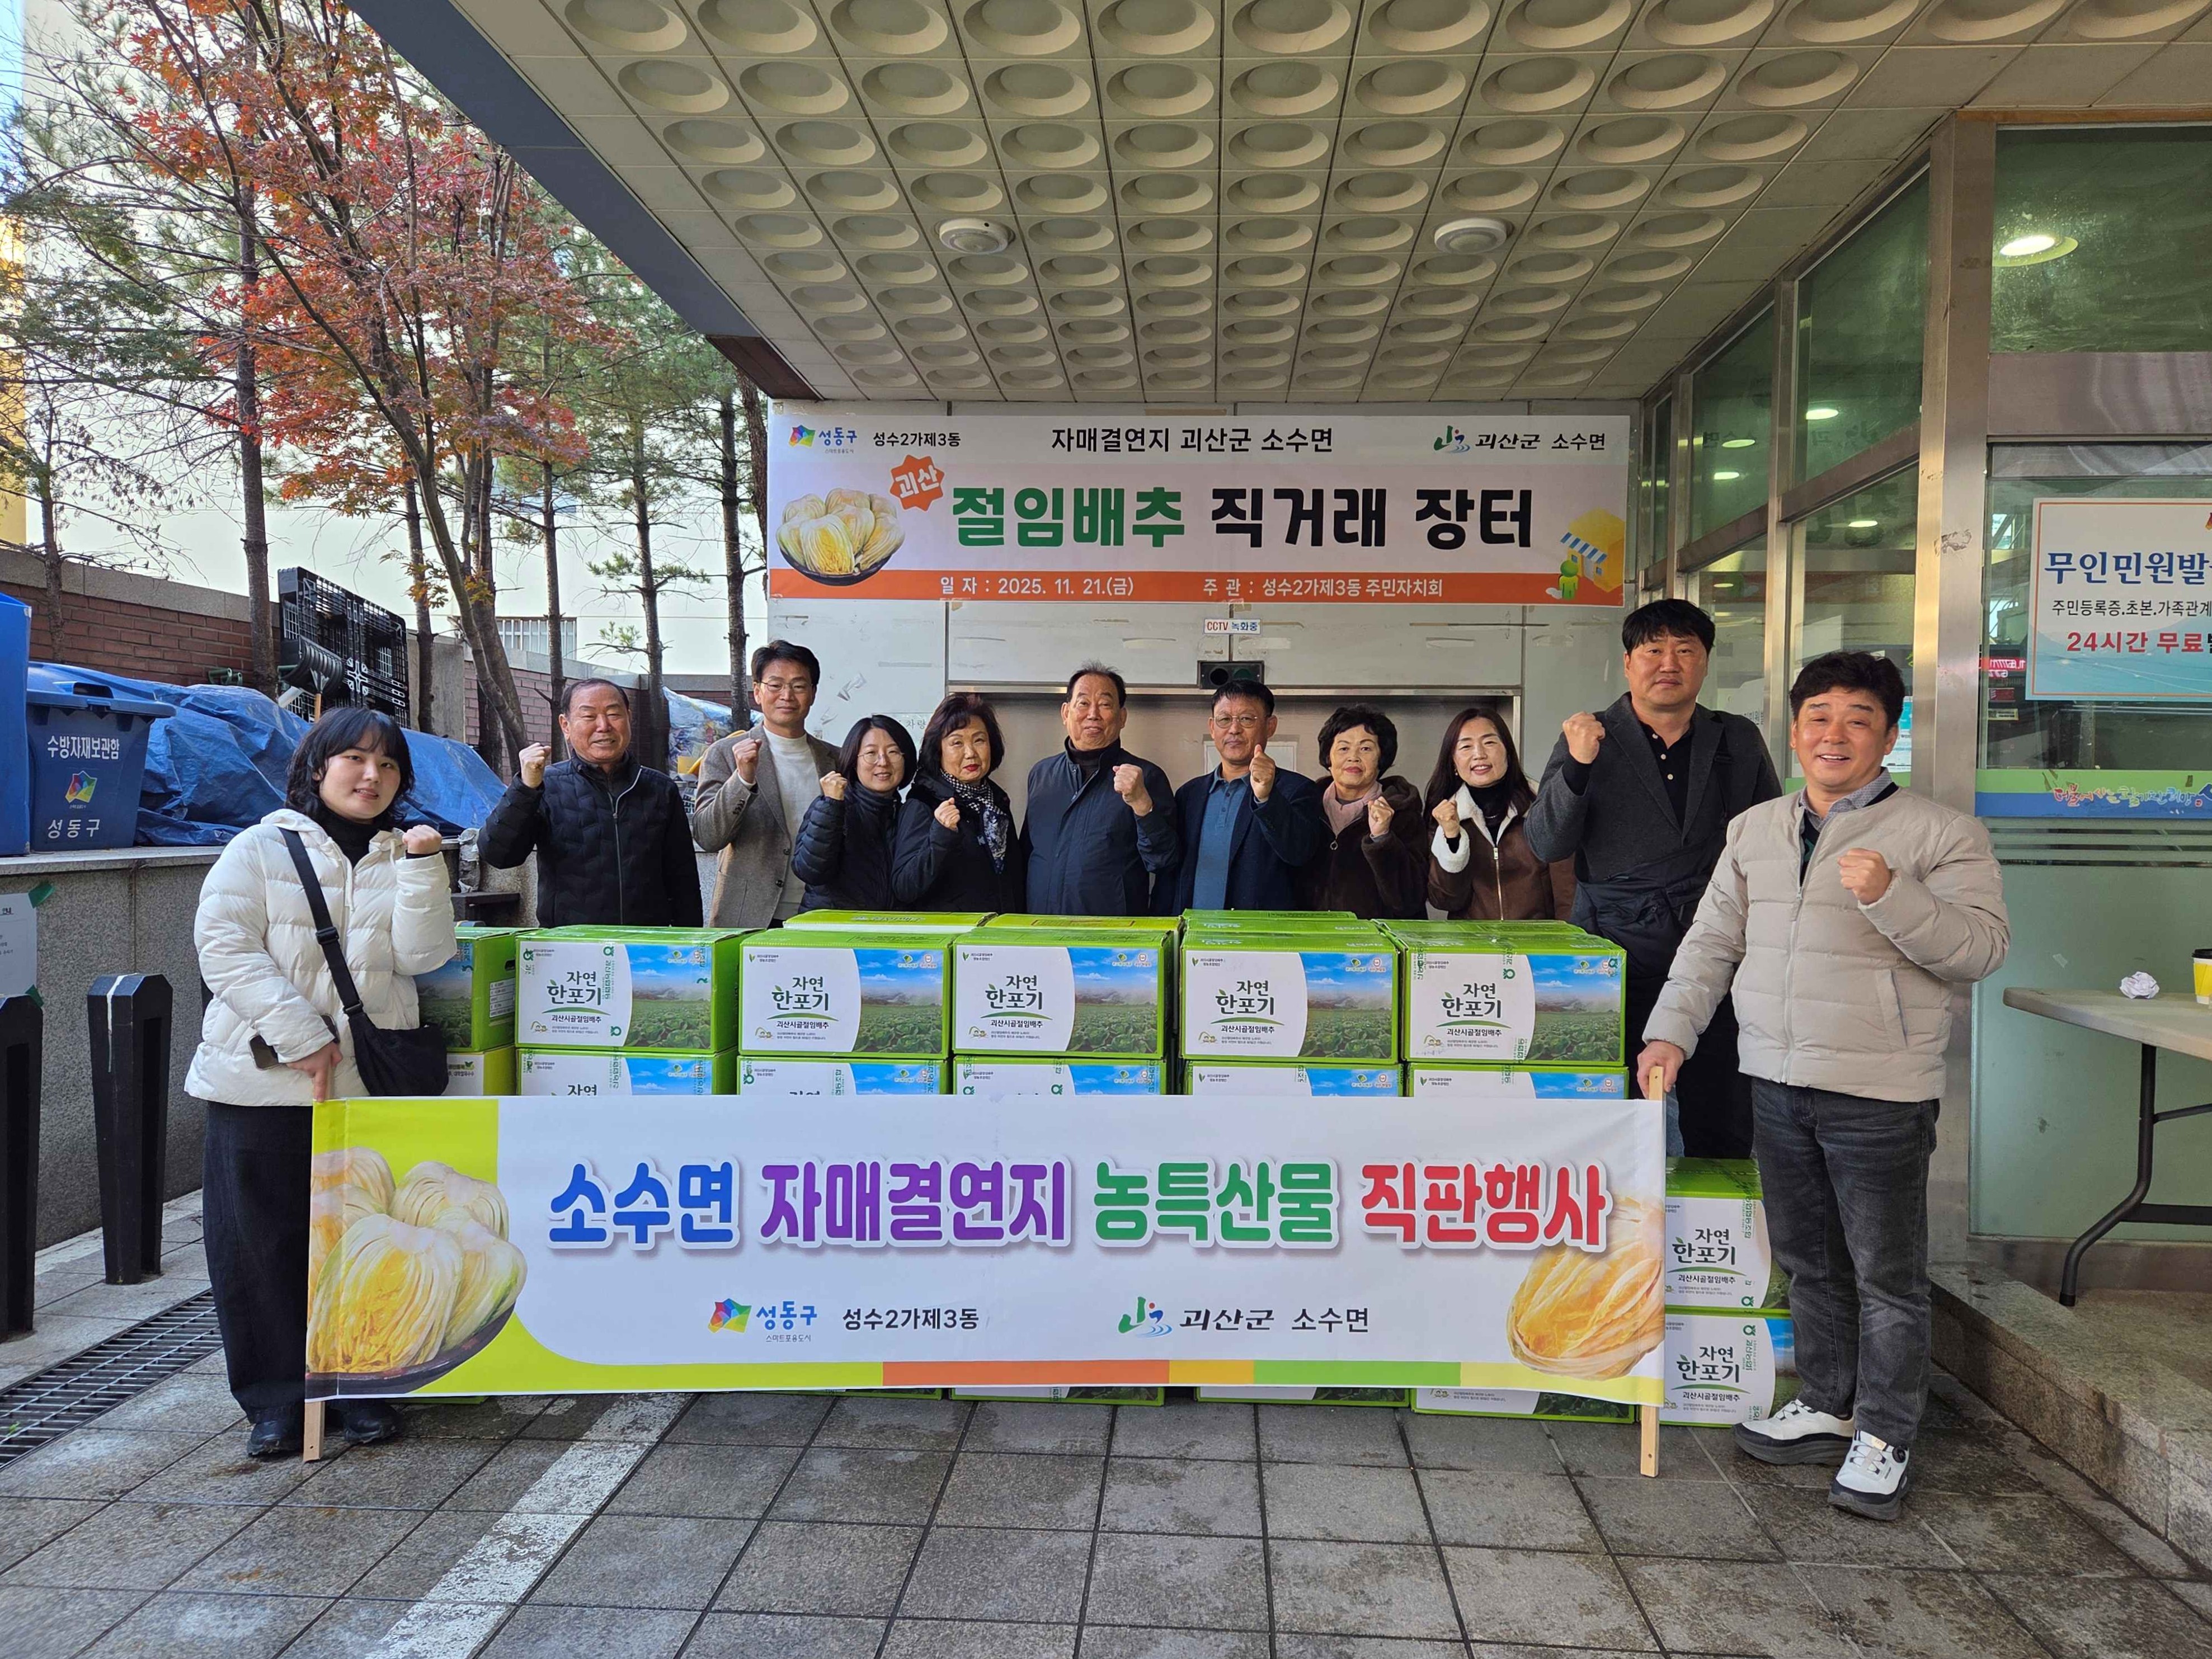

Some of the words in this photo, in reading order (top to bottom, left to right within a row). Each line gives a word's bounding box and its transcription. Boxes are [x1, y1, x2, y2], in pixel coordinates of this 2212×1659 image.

[818, 427, 857, 446] 성동구
[873, 432, 961, 447] 성수2가제3동
[1052, 428, 1169, 452] 자매결연지
[1180, 427, 1251, 452] 괴산군
[1261, 428, 1333, 452] 소수면
[1475, 433, 1541, 450] 괴산군
[1551, 433, 1606, 451] 소수면
[895, 465, 940, 498] 괴산
[952, 487, 1185, 547] 절임배추
[1212, 488, 1386, 548] 직거래
[1415, 489, 1532, 550] 장터
[2045, 552, 2212, 585] 무인민원발
[998, 578, 1046, 595] 2025.
[1055, 578, 1074, 595] 11.
[1262, 579, 1361, 597] 성수2가제3동
[1366, 579, 1442, 597] 주민자치회
[1207, 621, 1228, 630] CCTV
[1232, 622, 1258, 631] 녹화중
[2067, 632, 2148, 653] 24시간
[48, 736, 119, 760] 수방자재보관함
[566, 972, 596, 987] 자연
[792, 977, 823, 992] 자연
[1006, 975, 1037, 990] 자연
[1236, 981, 1268, 996] 자연
[547, 985, 601, 1006] 한포기
[985, 989, 1042, 1010] 한포기
[1463, 983, 1495, 999] 자연
[771, 991, 829, 1011] 한포기
[1216, 994, 1274, 1015] 한포기
[1441, 997, 1501, 1018] 한포기
[552, 1015, 601, 1023] 괴산시골절임배추
[776, 1021, 829, 1029] 괴산시골절임배추
[991, 1020, 1043, 1028] 괴산시골절임배추
[1221, 1025, 1274, 1034] 괴산시골절임배추
[1447, 1028, 1502, 1036] 괴산시골절임배추
[550, 1162, 733, 1245] 소수면
[760, 1161, 1065, 1242] 자매결연지
[1094, 1162, 1333, 1242] 농특산물
[1362, 1162, 1606, 1246] 직판행사
[1695, 1229, 1729, 1245] 자연
[1672, 1242, 1735, 1265] 한포기
[1678, 1275, 1735, 1284] 괴산시골절임배추
[756, 1300, 817, 1331] 성동구
[843, 1308, 979, 1330] 성수2가제3동
[1179, 1309, 1274, 1331] 괴산군
[1292, 1308, 1369, 1333] 소수면
[765, 1334, 812, 1342] 스마트포용도시
[1699, 1346, 1733, 1363] 자연
[1677, 1359, 1739, 1383] 한포기
[1683, 1392, 1740, 1402] 괴산시골절임배추
